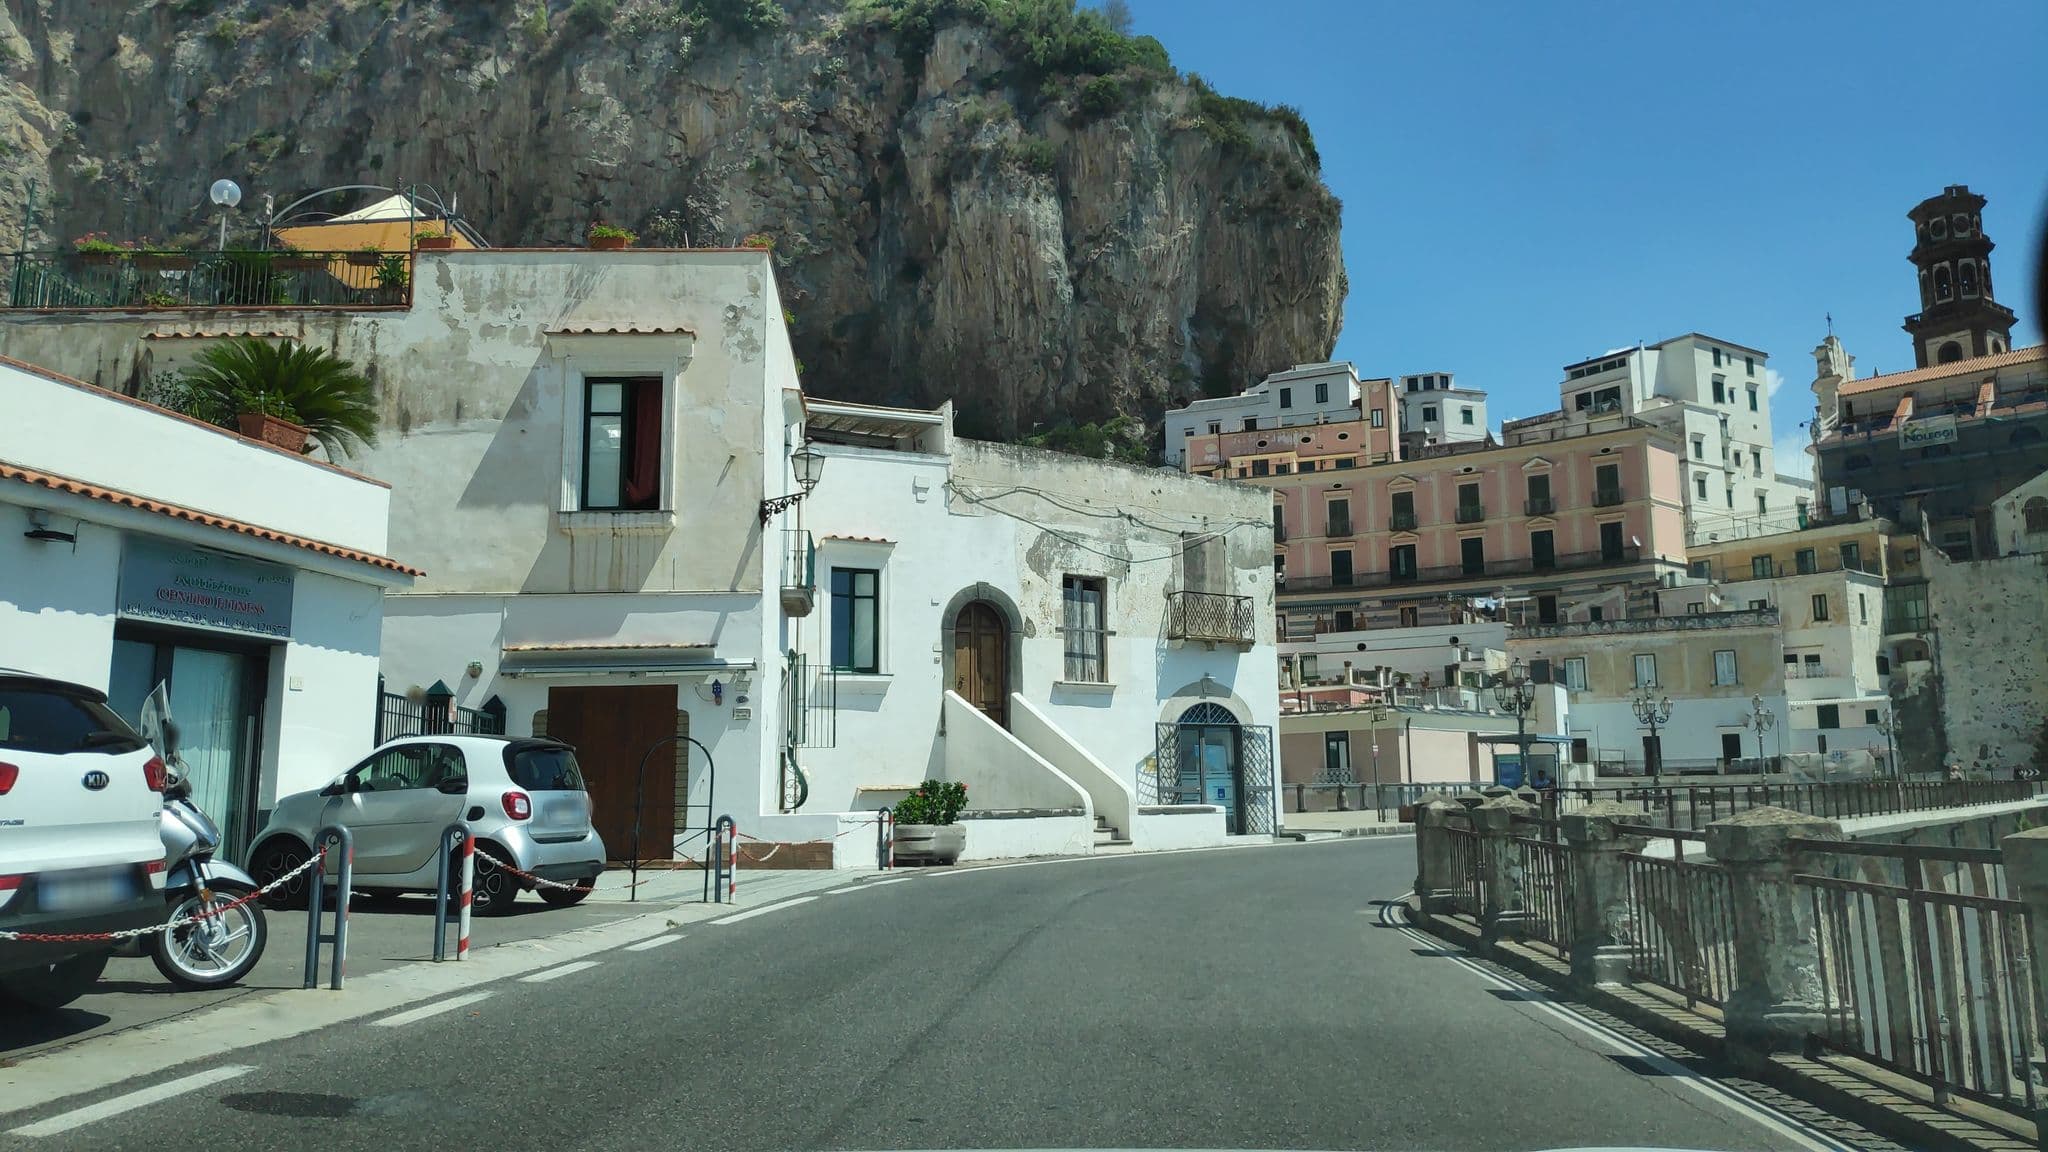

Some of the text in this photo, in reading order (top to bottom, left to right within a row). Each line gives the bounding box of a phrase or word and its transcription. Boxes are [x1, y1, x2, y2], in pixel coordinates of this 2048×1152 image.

[1904, 428, 1954, 443] NOLEGGI
[157, 587, 265, 616] CENTRO FITNESS
[88, 774, 107, 786] KIA
